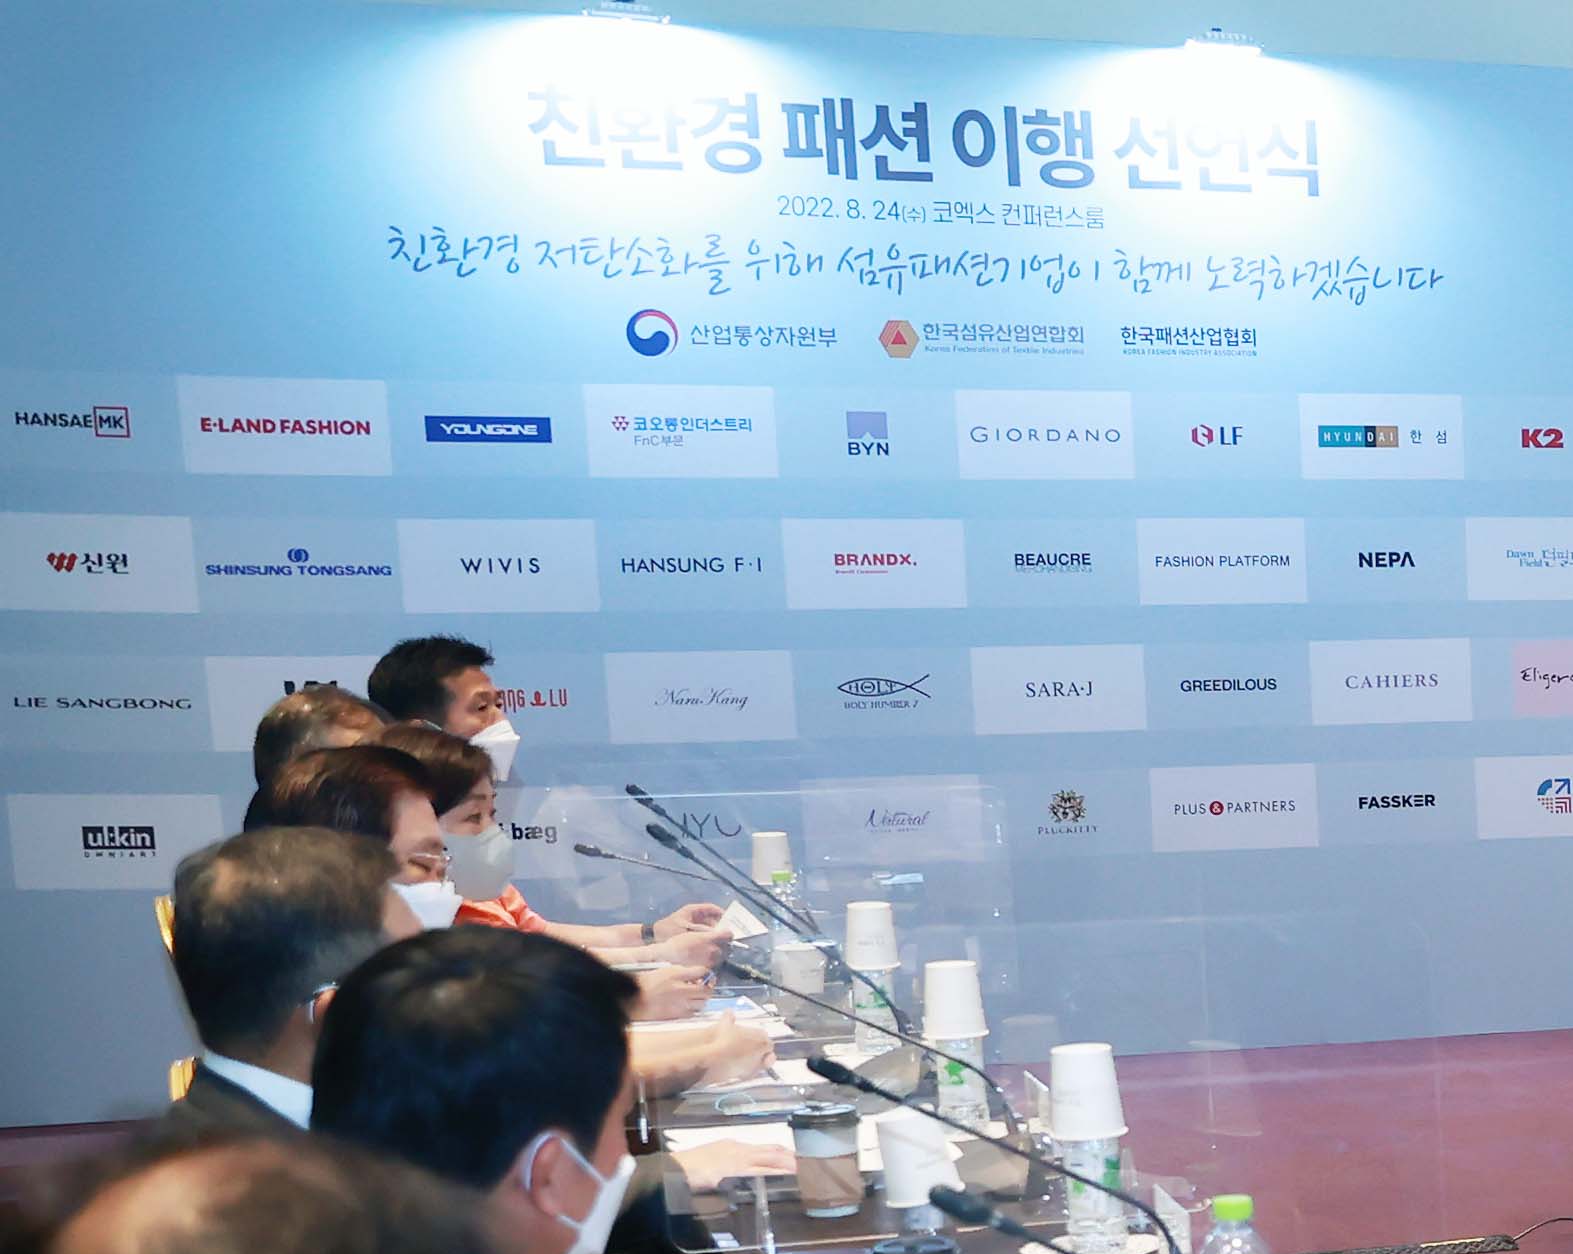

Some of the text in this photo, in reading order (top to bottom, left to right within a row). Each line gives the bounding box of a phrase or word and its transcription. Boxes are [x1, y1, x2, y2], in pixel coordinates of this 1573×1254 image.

[780, 97, 934, 182] 패션
[952, 105, 1096, 189] 이행
[778, 195, 840, 220] 2022.
[874, 201, 927, 225] 24(수)
[933, 201, 996, 225] 코엑스
[1001, 203, 1105, 230] 컨퍼런스룸
[387, 226, 1446, 306] 친환경 저탄소화를 위해 섬유패션기업이 함께 노력하겠습니다
[690, 323, 839, 348] 산업통상자원부
[922, 322, 1085, 344] 한국섬유산업연합회
[1120, 325, 1258, 347] 한국패션산업협회
[280, 418, 371, 437] FASHION
[441, 422, 538, 437] YOUNGONE
[633, 415, 753, 434] 코오롱인더스트리
[633, 434, 685, 449] FnC부문
[970, 425, 1121, 444] GIORDANO
[1220, 425, 1244, 446] LF
[1323, 431, 1394, 443] HYUNDAI
[1521, 428, 1564, 449] K2
[848, 441, 891, 458] BYN
[80, 552, 129, 575] 신원
[461, 556, 542, 575] WIVIS
[621, 556, 725, 575] HANSUNG
[1014, 552, 1092, 567] BEAUCRE
[1155, 554, 1291, 568] FASHION PLATFORM
[1358, 551, 1416, 569] NEPA
[205, 564, 392, 578] SHINSUNG TONGSANG
[1180, 678, 1278, 693] GREEDILOUS
[1345, 672, 1439, 690] CAHIERS
[15, 696, 192, 710] LIE SANGBONG
[1174, 802, 1207, 816] PLUS
[1227, 799, 1296, 815] PARTNERS
[1358, 794, 1436, 811] FASSKER
